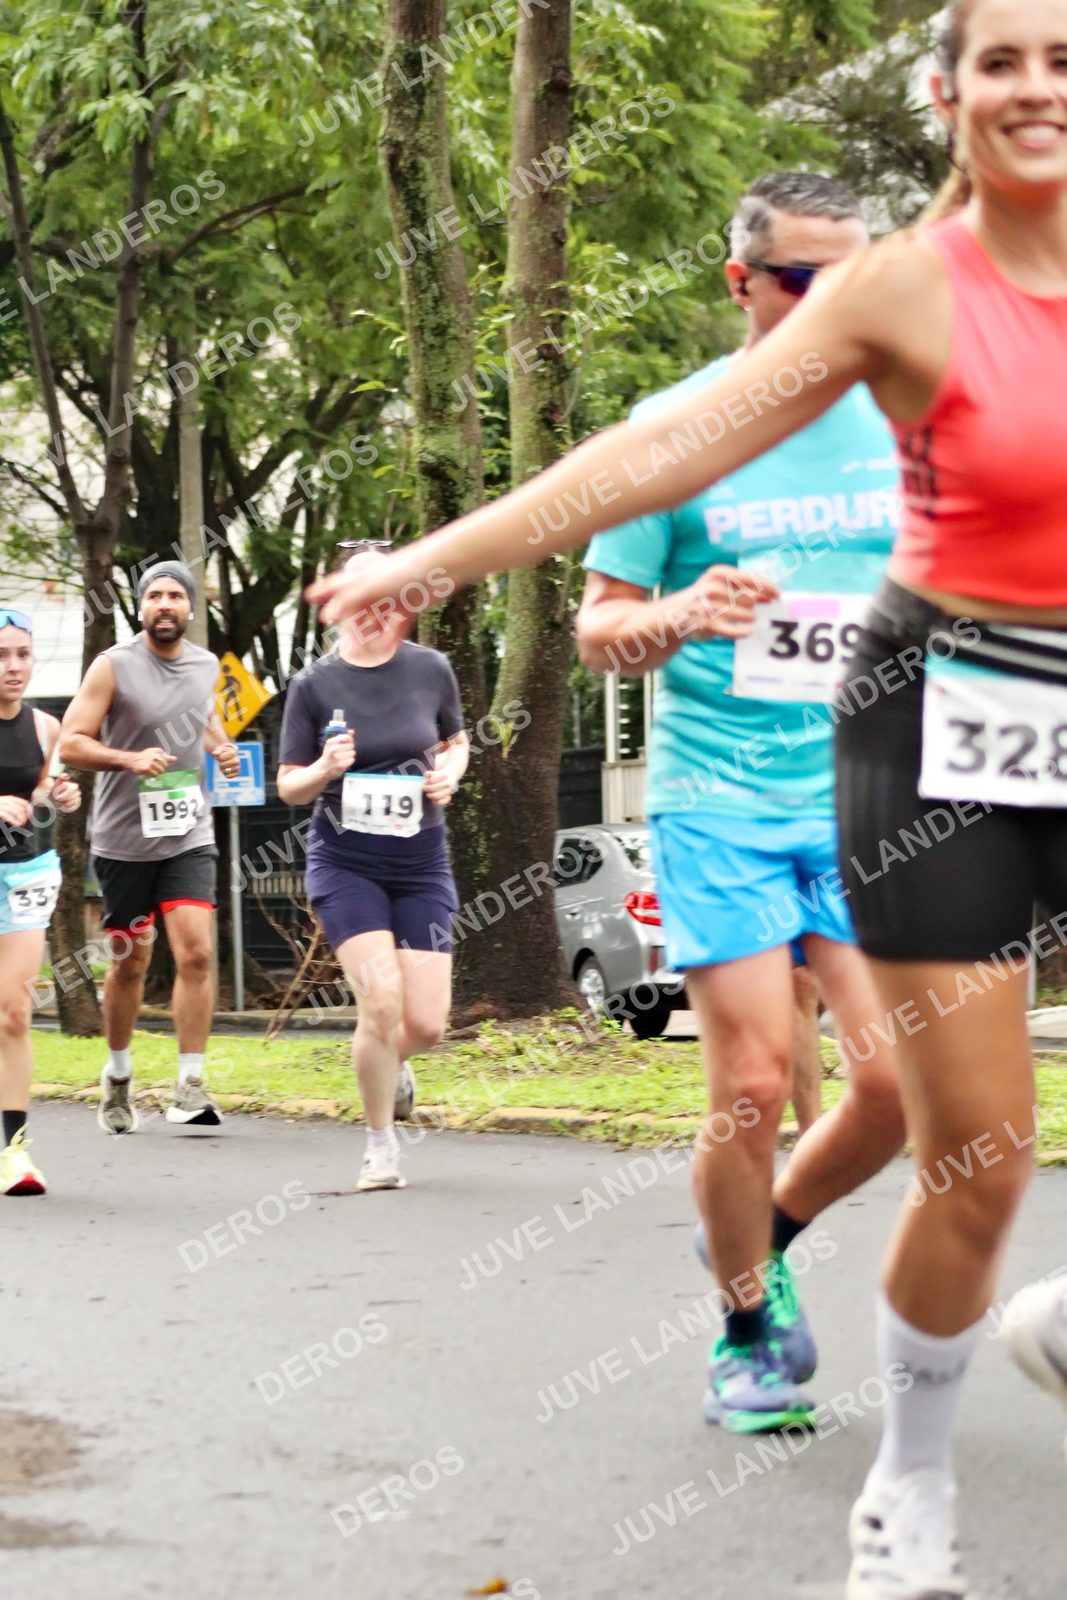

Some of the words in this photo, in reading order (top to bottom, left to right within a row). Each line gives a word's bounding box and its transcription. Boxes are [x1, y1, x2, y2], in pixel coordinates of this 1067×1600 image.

[148, 798, 199, 821] 1992
[363, 793, 413, 819] 119
[15, 885, 57, 908] 33
